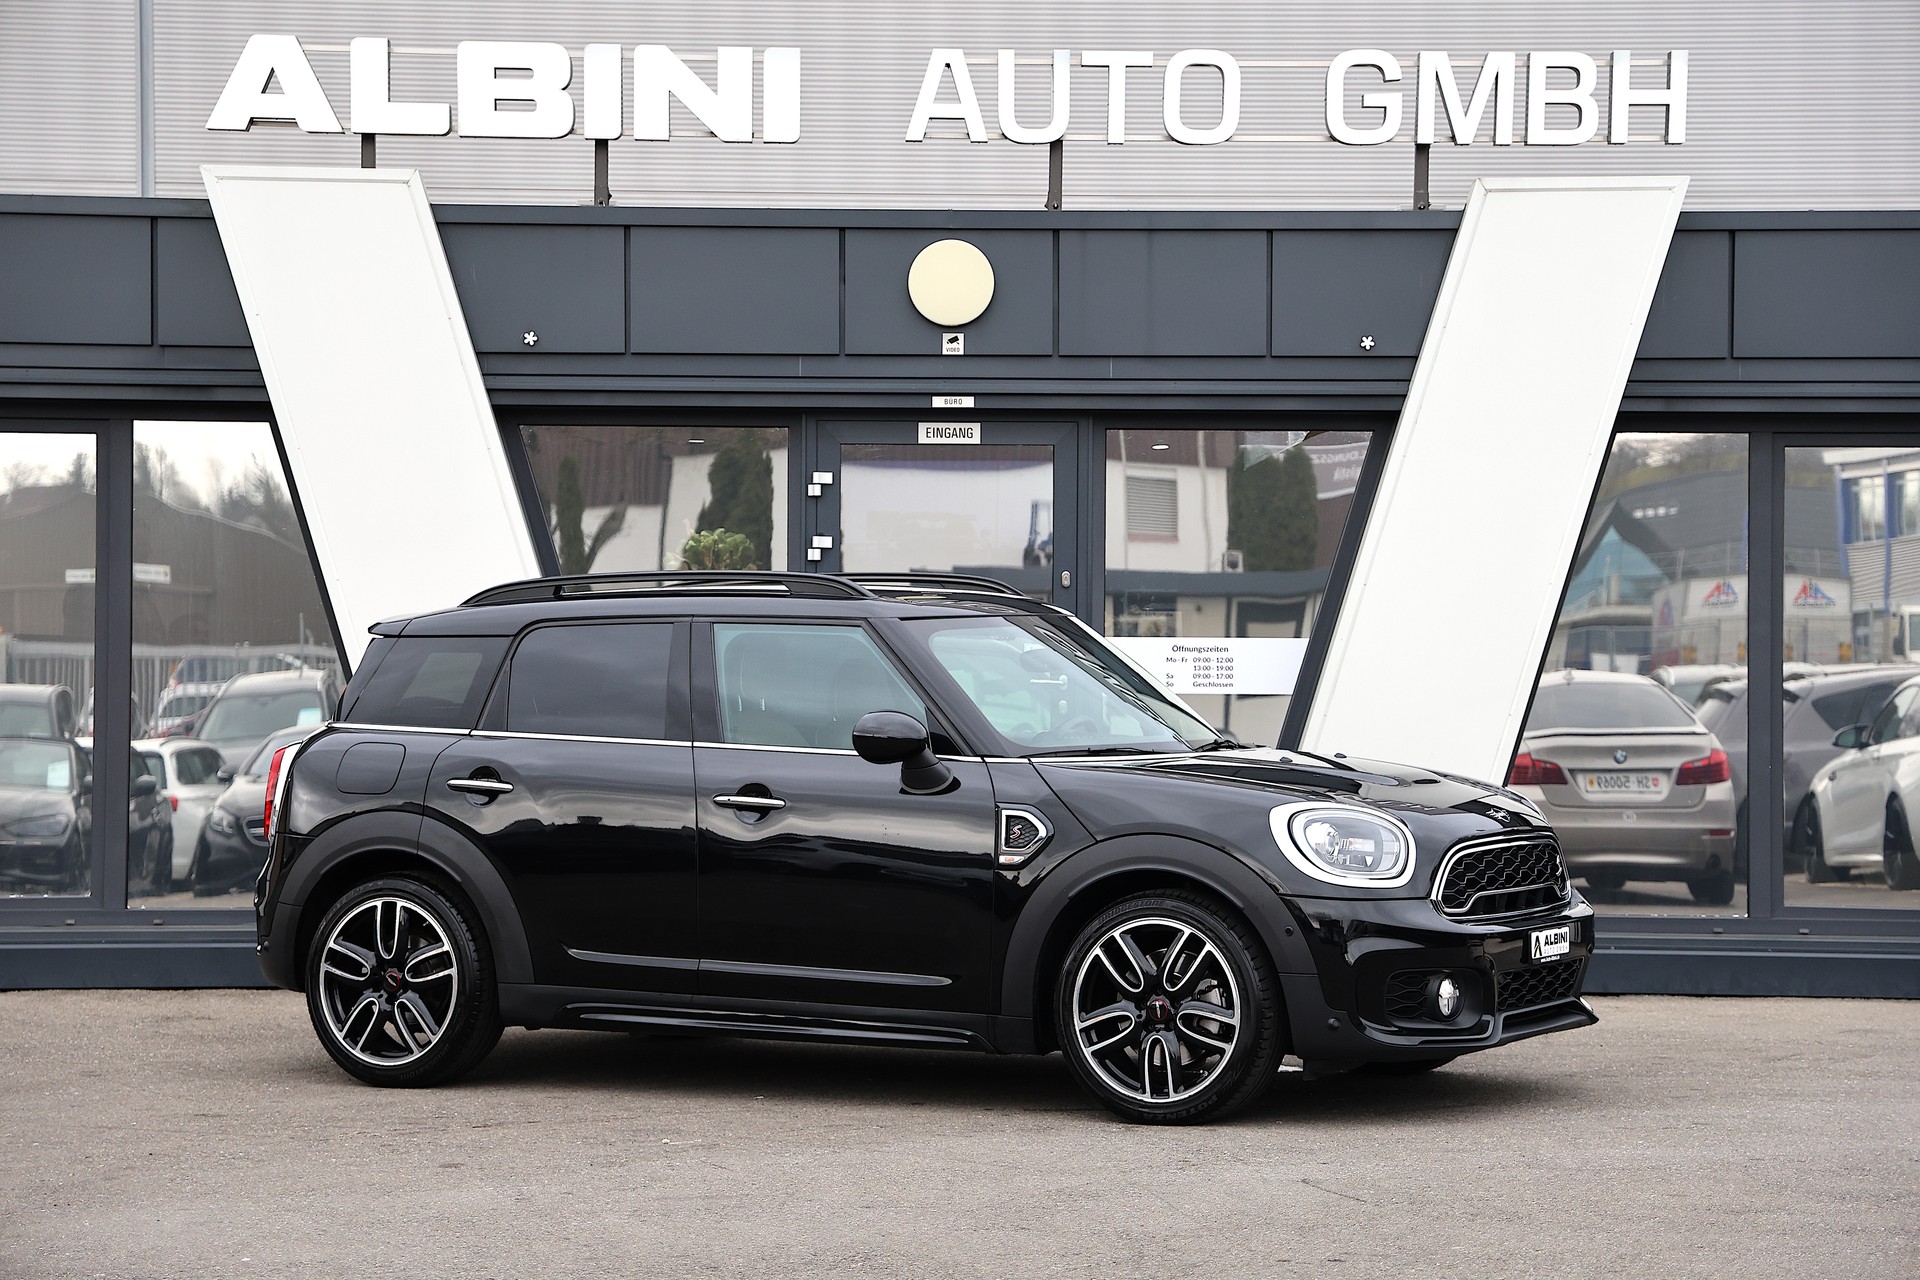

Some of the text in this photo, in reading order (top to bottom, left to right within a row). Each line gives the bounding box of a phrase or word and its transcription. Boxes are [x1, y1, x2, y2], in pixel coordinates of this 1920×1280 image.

[206, 34, 1689, 146] ALBINI AUTO GMBH
[944, 397, 963, 405] BÜRO
[925, 427, 974, 439] EINGANG
[1172, 644, 1229, 654] Öffnungszeiten
[1010, 824, 1023, 841] S
[1544, 931, 1568, 947] ALBINI
[1143, 1094, 1218, 1119] POTENZA
